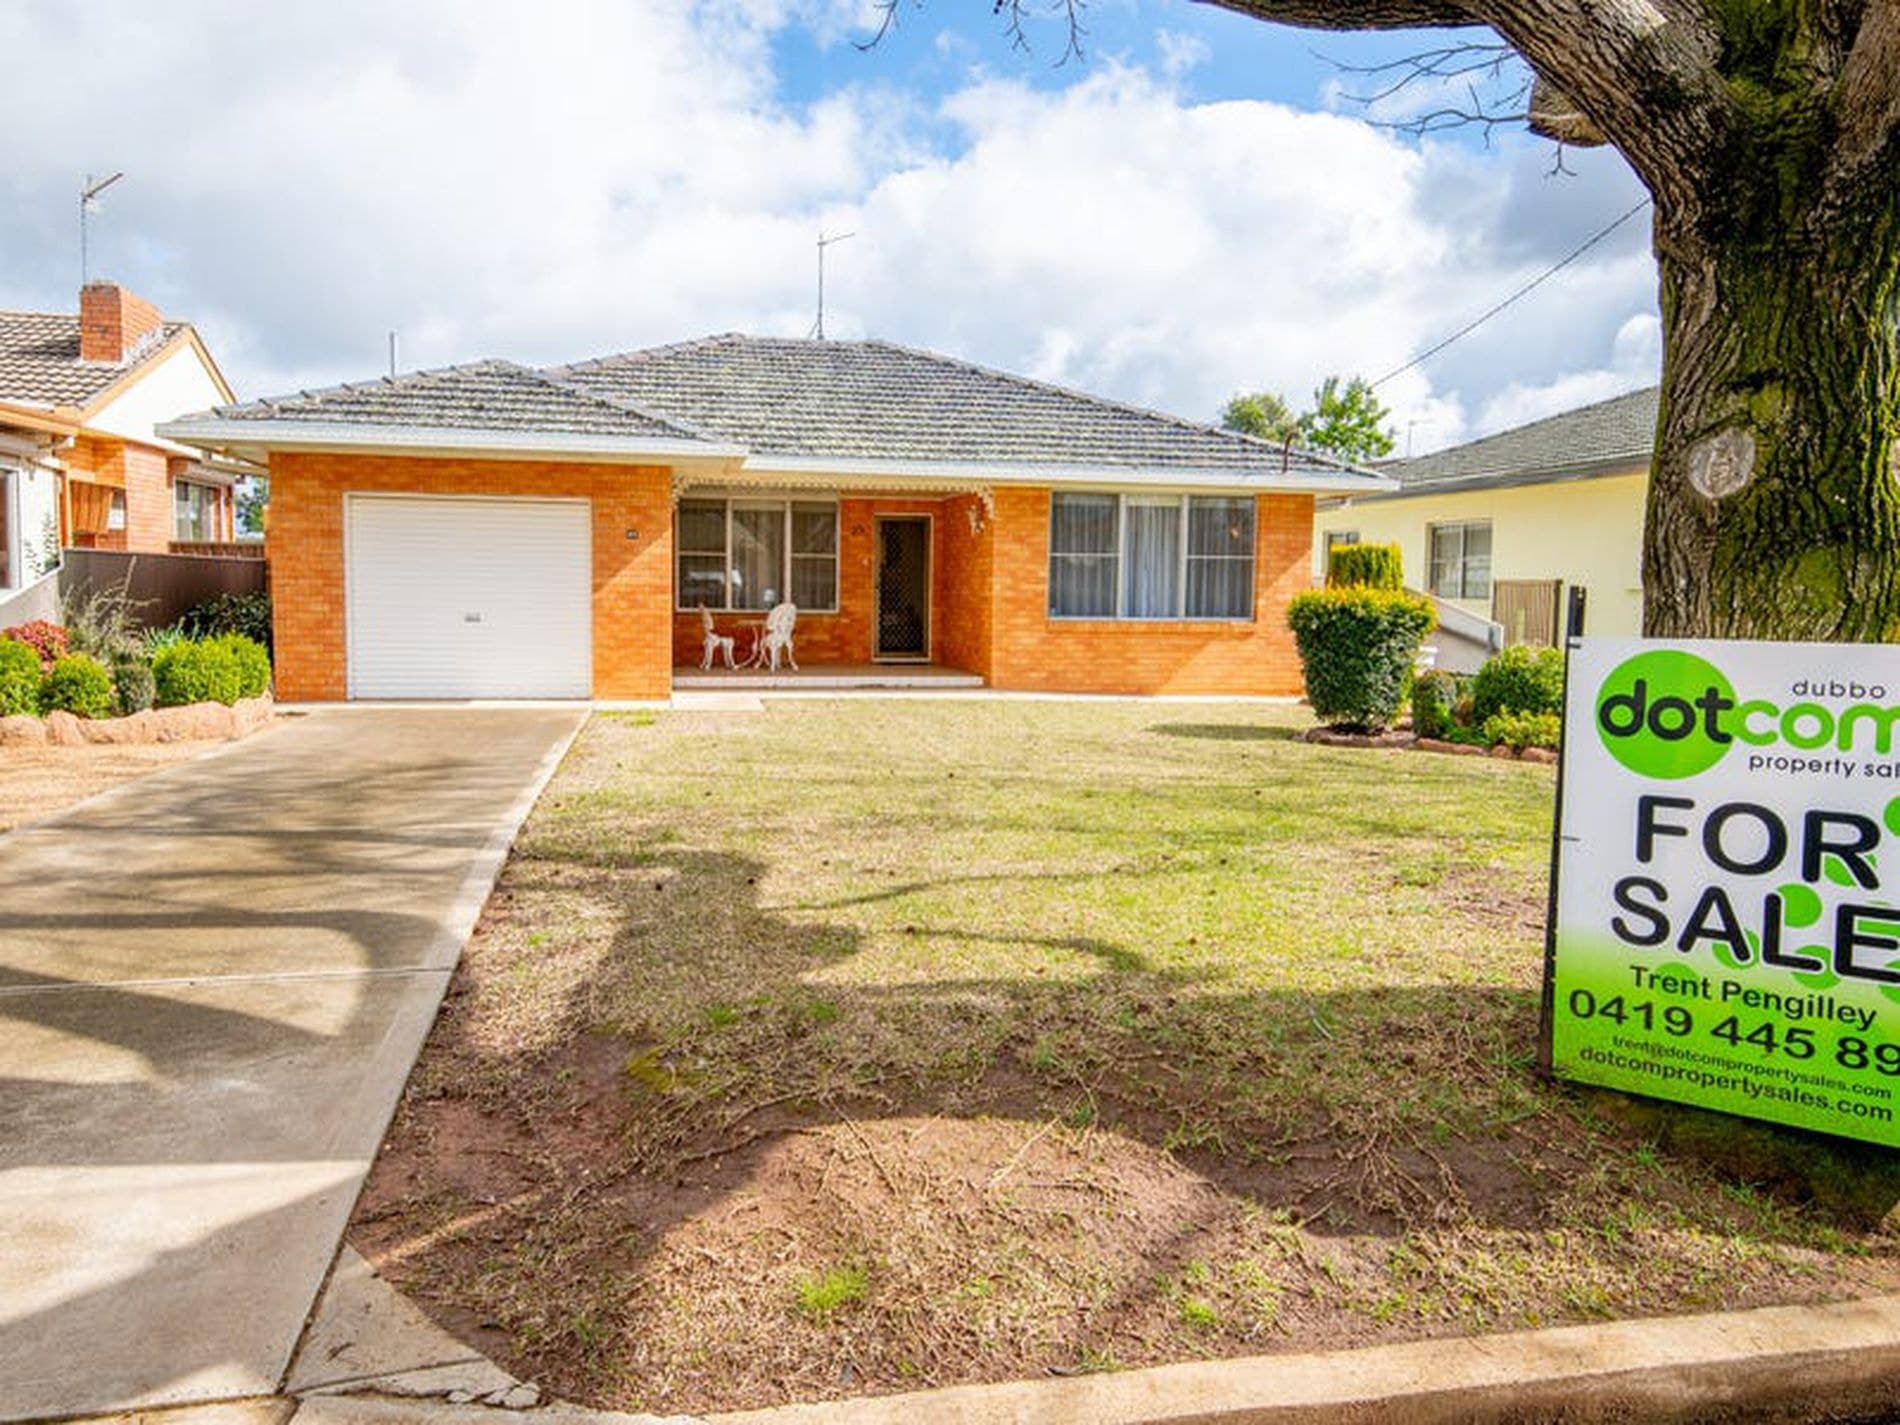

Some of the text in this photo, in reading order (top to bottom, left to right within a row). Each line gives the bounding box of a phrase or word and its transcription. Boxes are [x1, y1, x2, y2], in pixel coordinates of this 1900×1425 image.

[1792, 680, 1886, 699] dubbo
[1749, 755, 1856, 778] property
[1636, 795, 1881, 890] FOR
[1611, 876, 1900, 983] SALE
[1569, 989, 1900, 1076] 0419 445 89
[1630, 965, 1877, 1031] Trent Pengilley
[1580, 1046, 1893, 1121] dotcompropertysales.com
[1612, 1036, 1892, 1099] trent@dotcompropertysales.com
